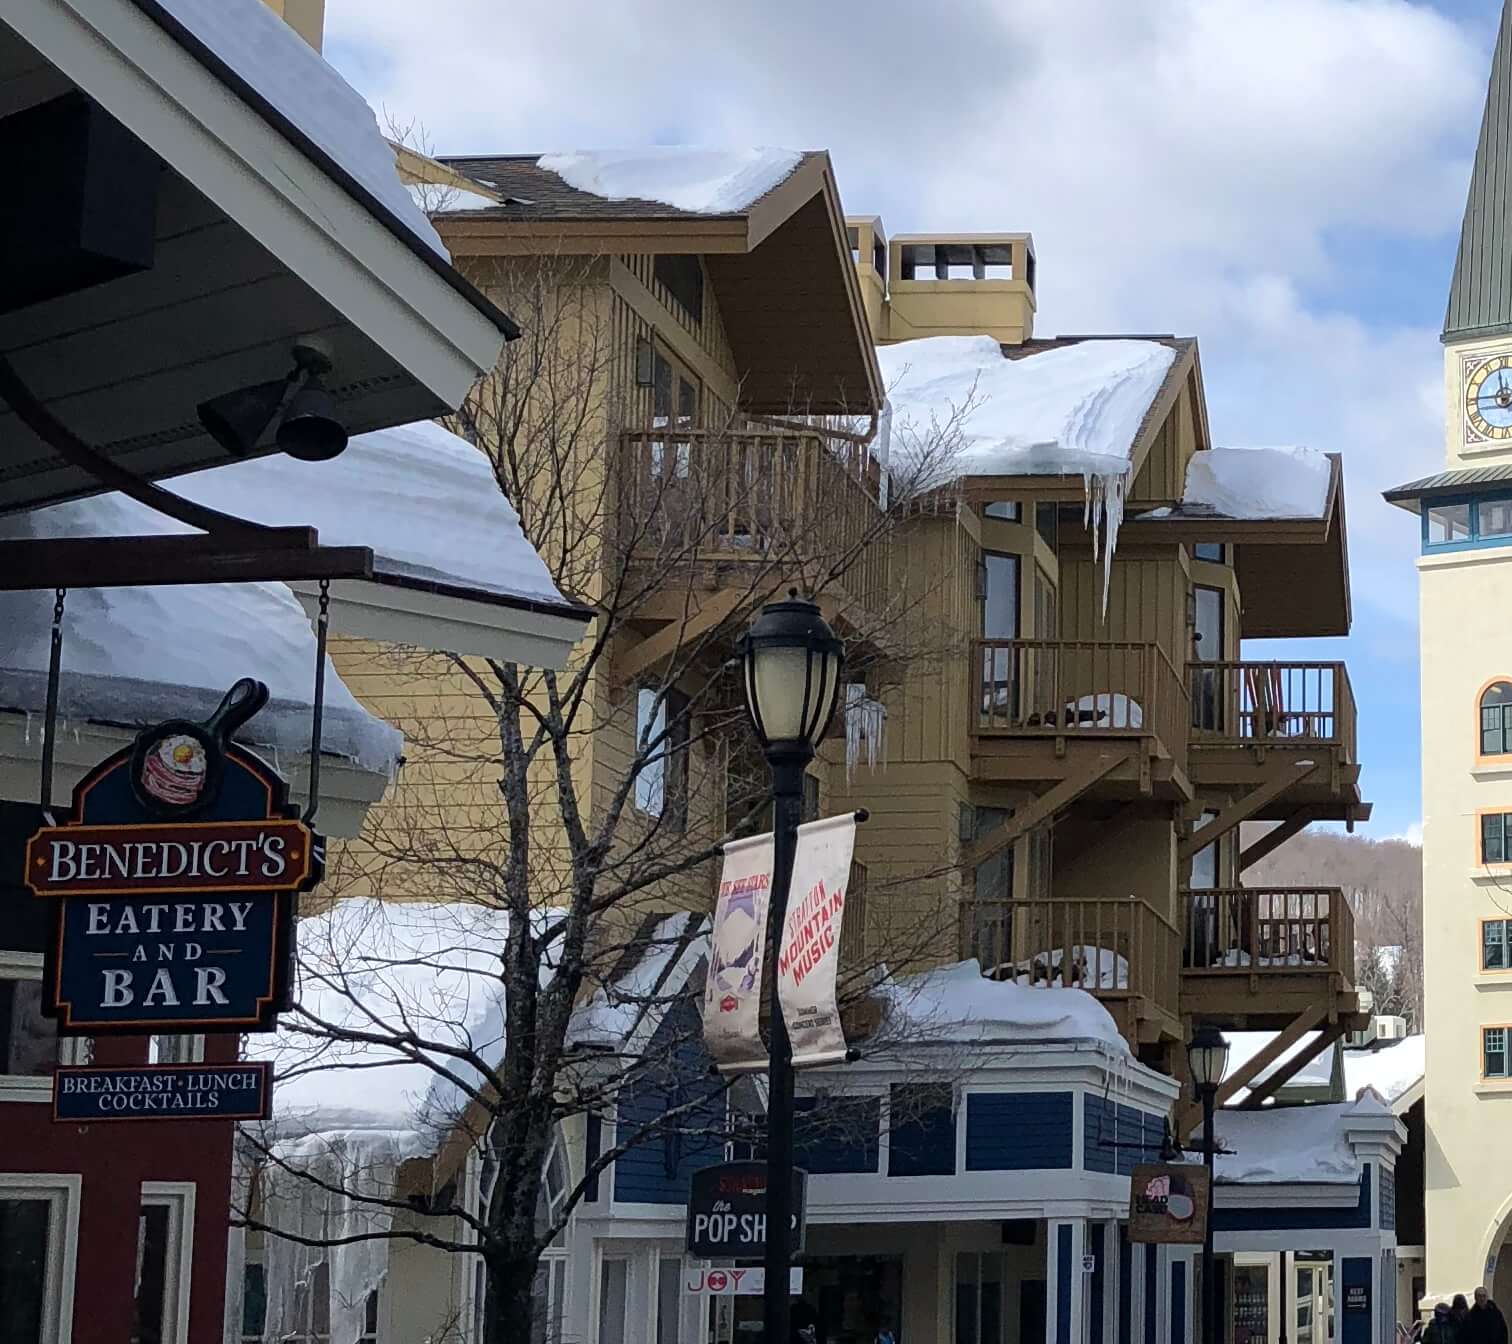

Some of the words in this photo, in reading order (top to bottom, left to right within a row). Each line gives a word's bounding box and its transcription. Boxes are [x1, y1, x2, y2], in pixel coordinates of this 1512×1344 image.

[47, 833, 286, 882] BENEDICT'S
[85, 902, 253, 935] EATERY
[788, 879, 827, 940] STRATTON
[777, 887, 843, 977] MOUNTAIN
[132, 942, 203, 962] AND
[792, 925, 835, 988] MUSIC
[100, 966, 230, 1008] BAR
[183, 1072, 257, 1092] LUNCH
[98, 1091, 220, 1111] COCKTAILS
[712, 1200, 732, 1212] the
[687, 1269, 747, 1292] JOY
